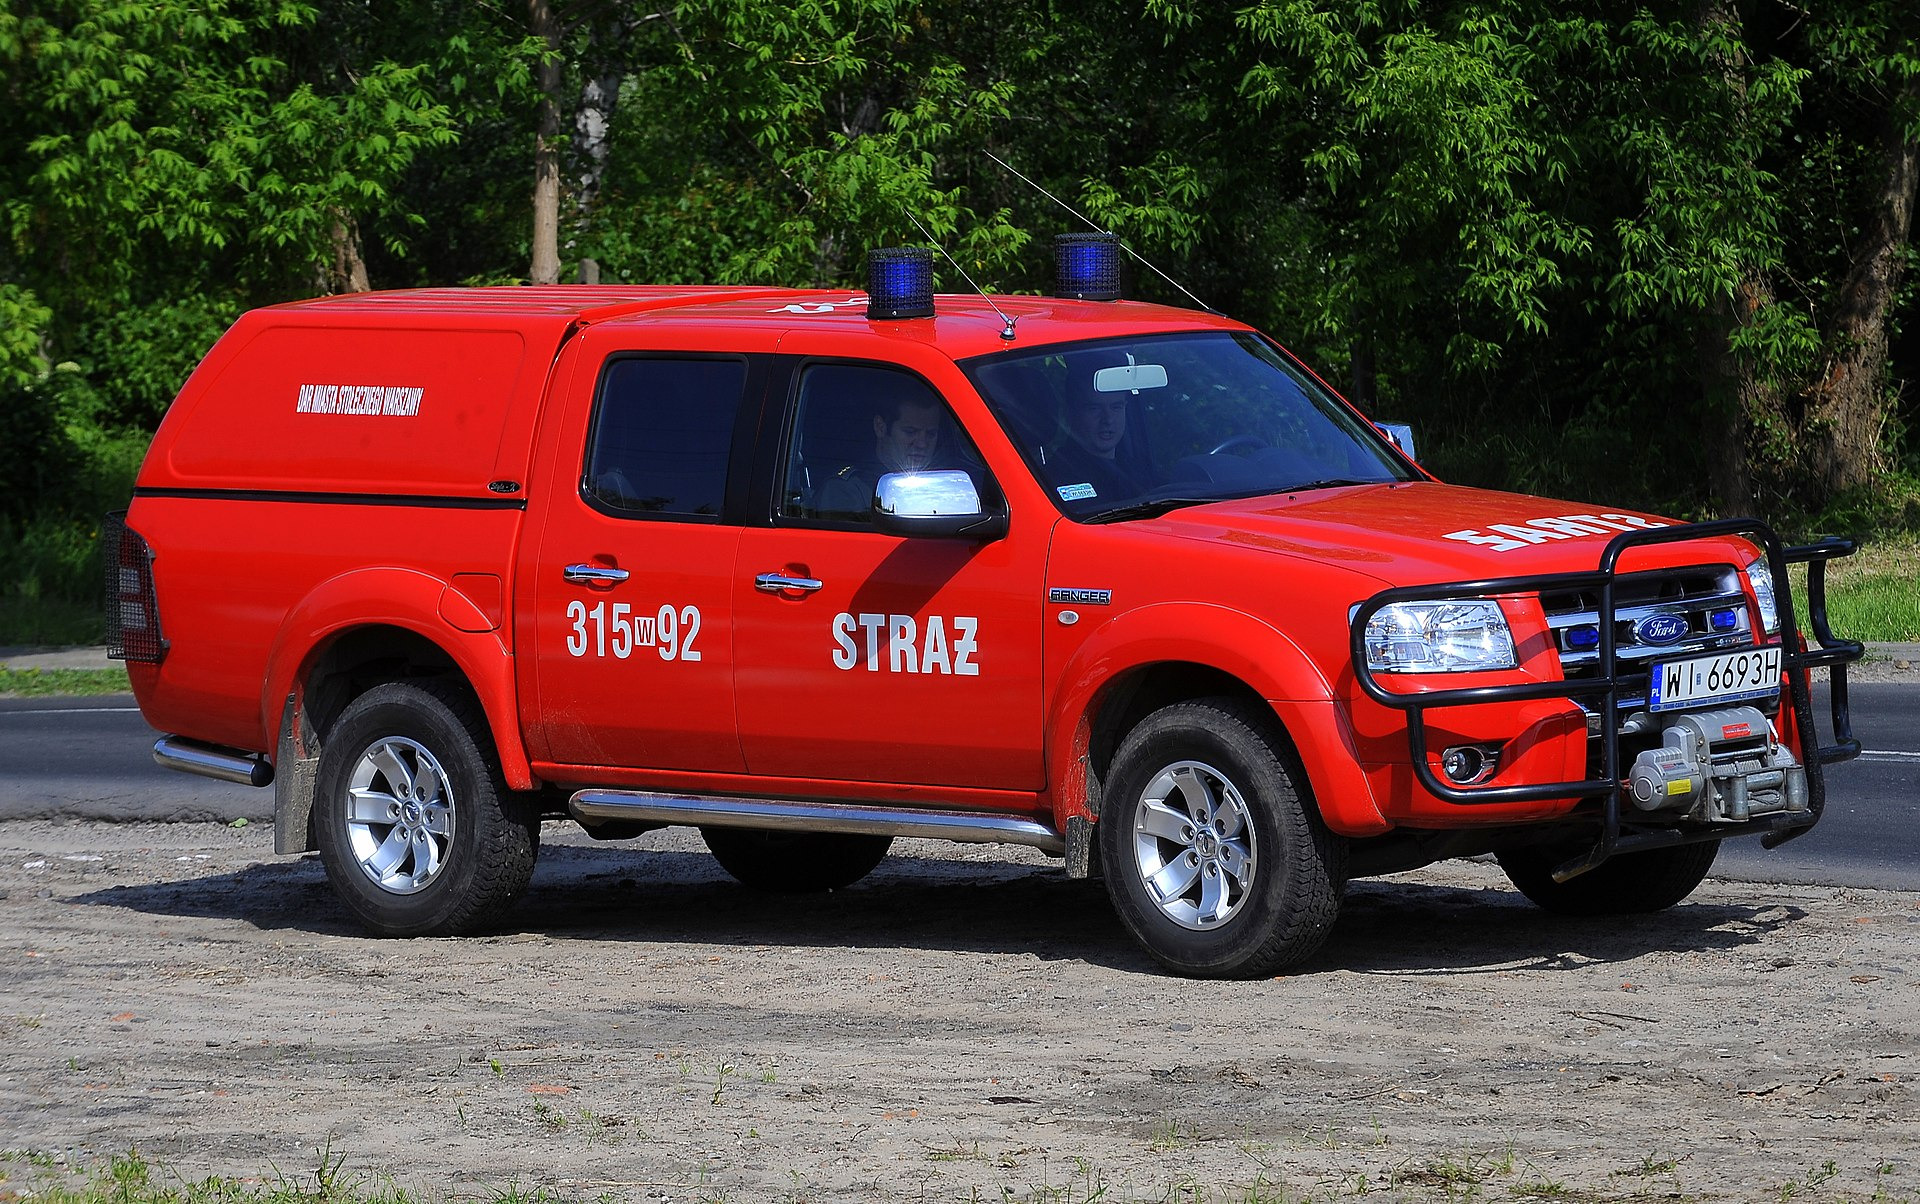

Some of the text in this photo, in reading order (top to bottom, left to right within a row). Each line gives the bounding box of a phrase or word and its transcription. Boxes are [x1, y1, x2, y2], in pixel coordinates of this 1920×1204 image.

[296, 384, 315, 413] DAR
[311, 384, 339, 414] MIASTA
[382, 386, 424, 416] WARSZAWY
[1050, 589, 1110, 603] RANGER
[1649, 620, 1677, 637] Ford
[1667, 650, 1779, 698] WI 6693H
[1651, 687, 1660, 698] PL
